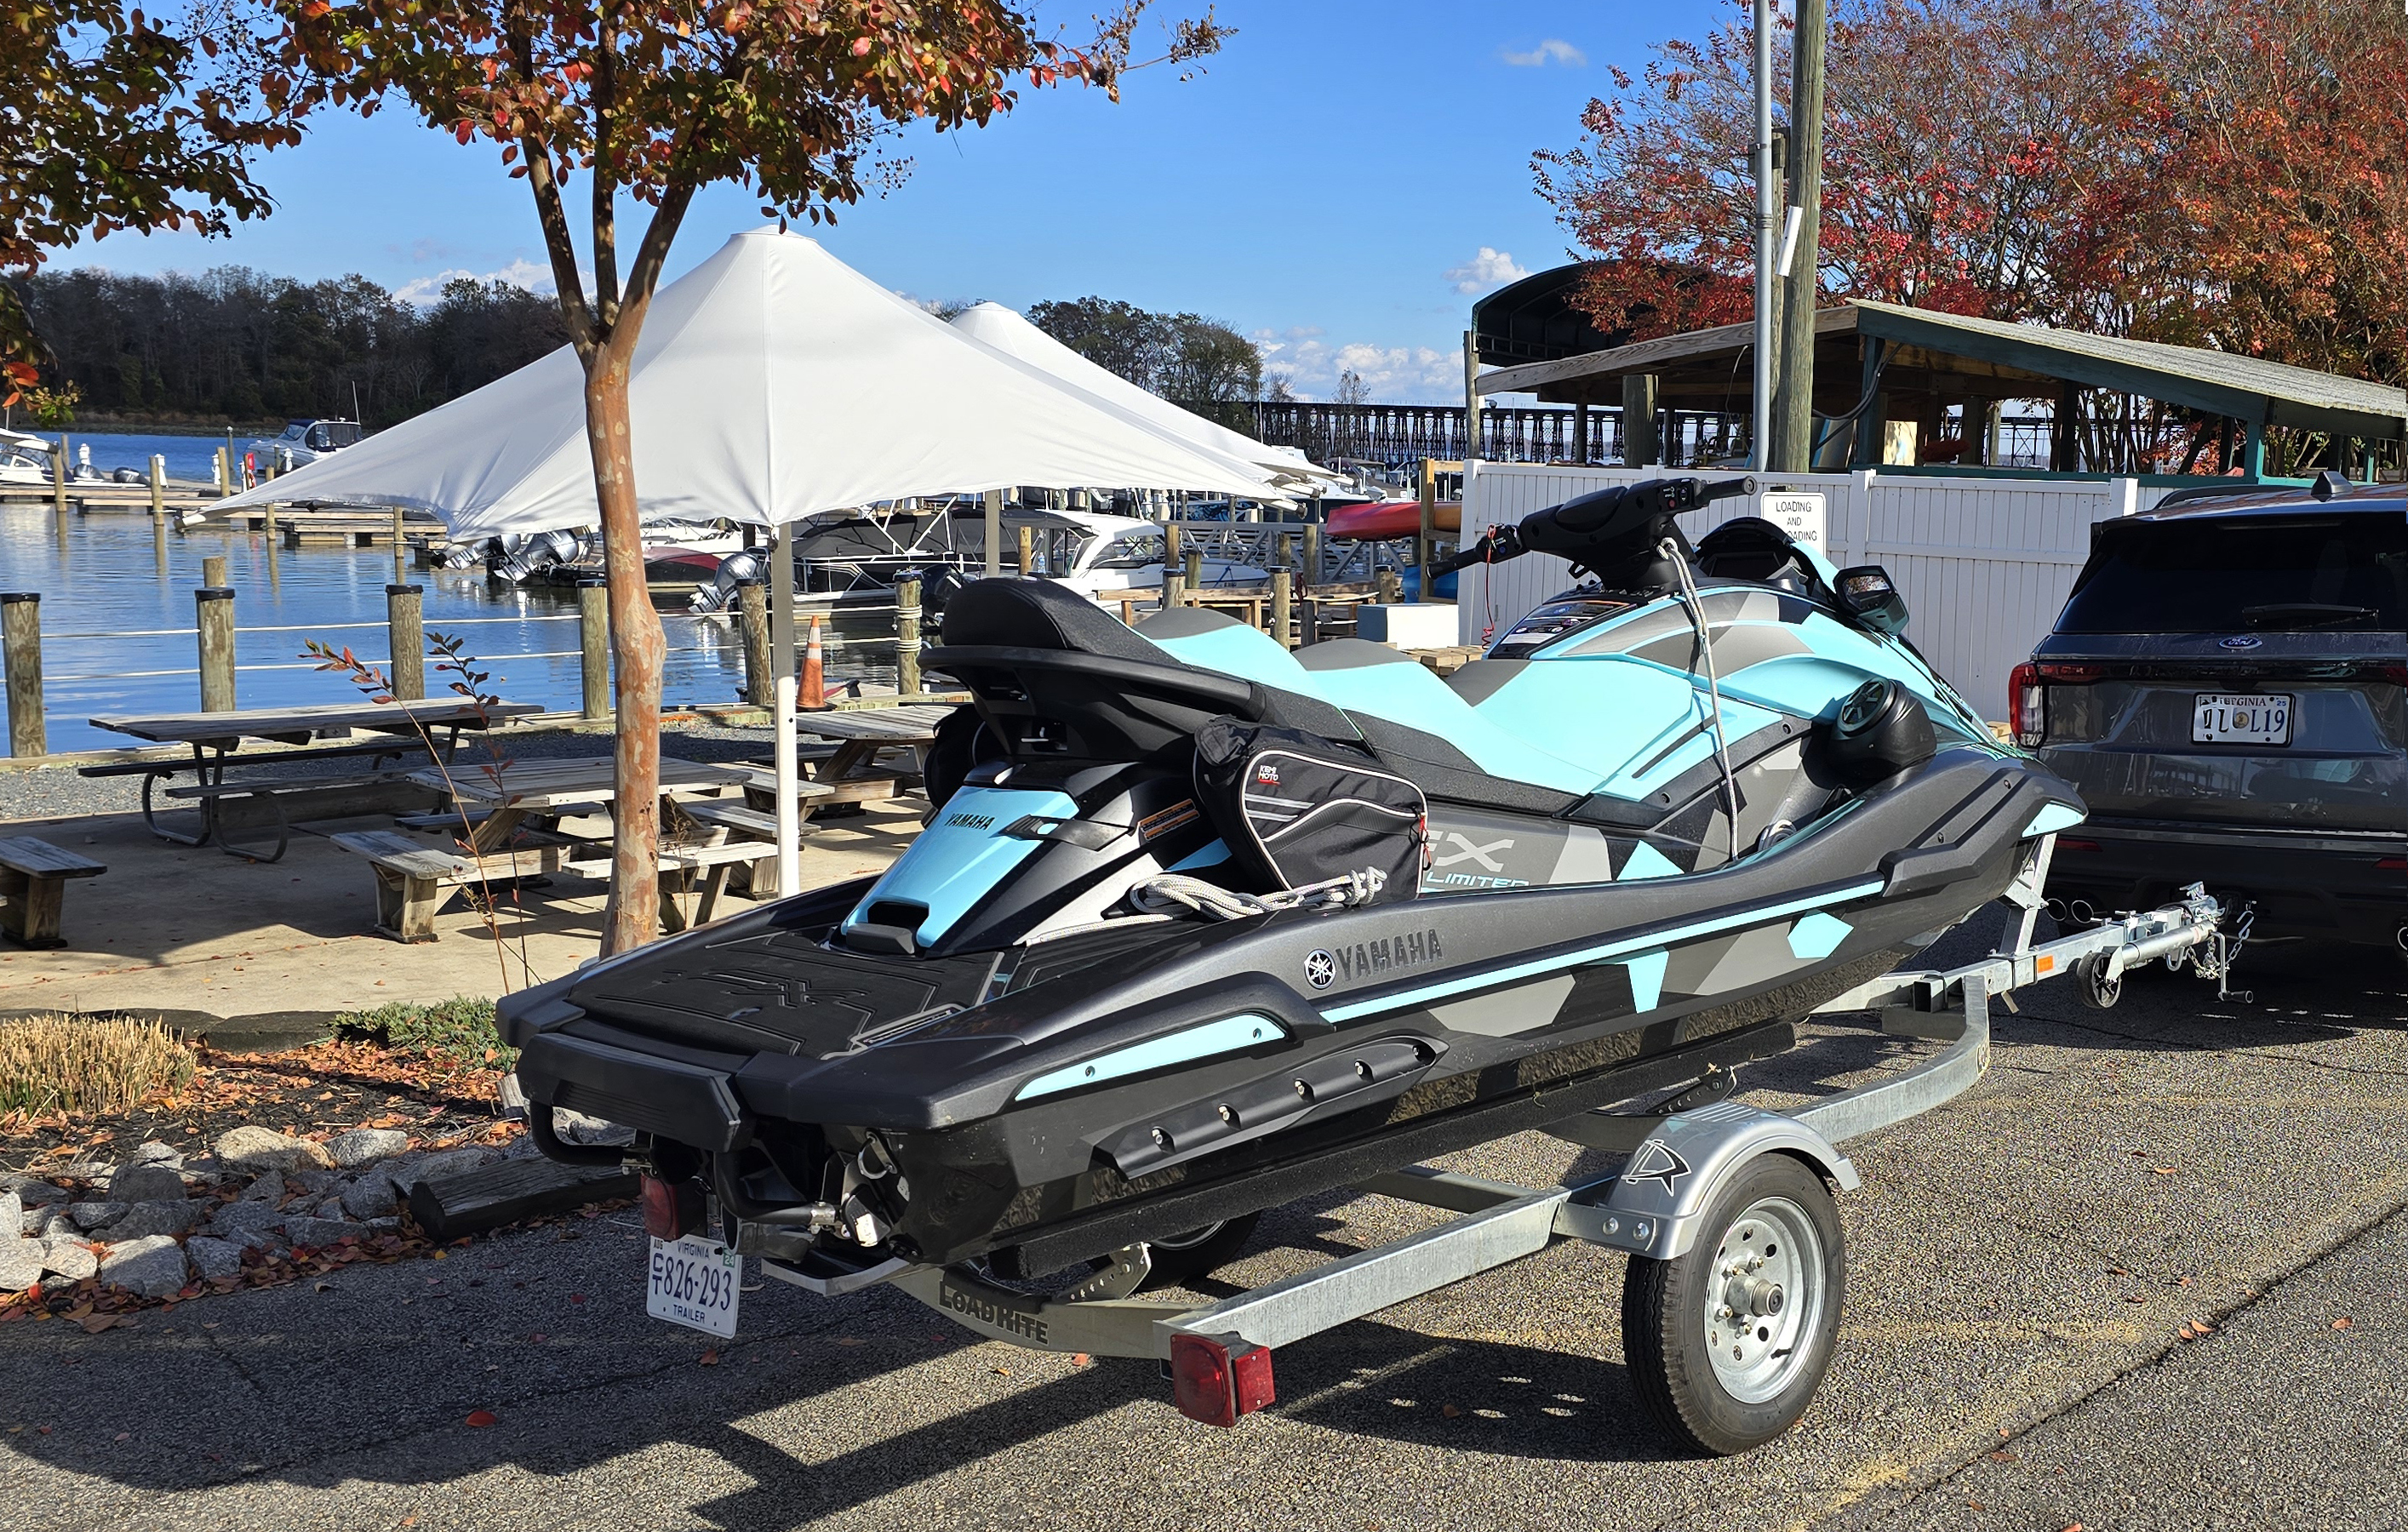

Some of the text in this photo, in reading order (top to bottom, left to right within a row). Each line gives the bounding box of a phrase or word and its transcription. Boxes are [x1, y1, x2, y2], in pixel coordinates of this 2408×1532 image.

[1776, 500, 1812, 512] LOADING
[1787, 517, 1802, 526] AND
[1787, 529, 1818, 542] OADING
[944, 813, 996, 831] YAMAHA
[1335, 929, 1444, 982] YAMAHA
[677, 1241, 710, 1259] VIRGINIA
[724, 1255, 735, 1266] 24
[664, 1255, 732, 1312] 826-293
[673, 1304, 706, 1323] TRAILER
